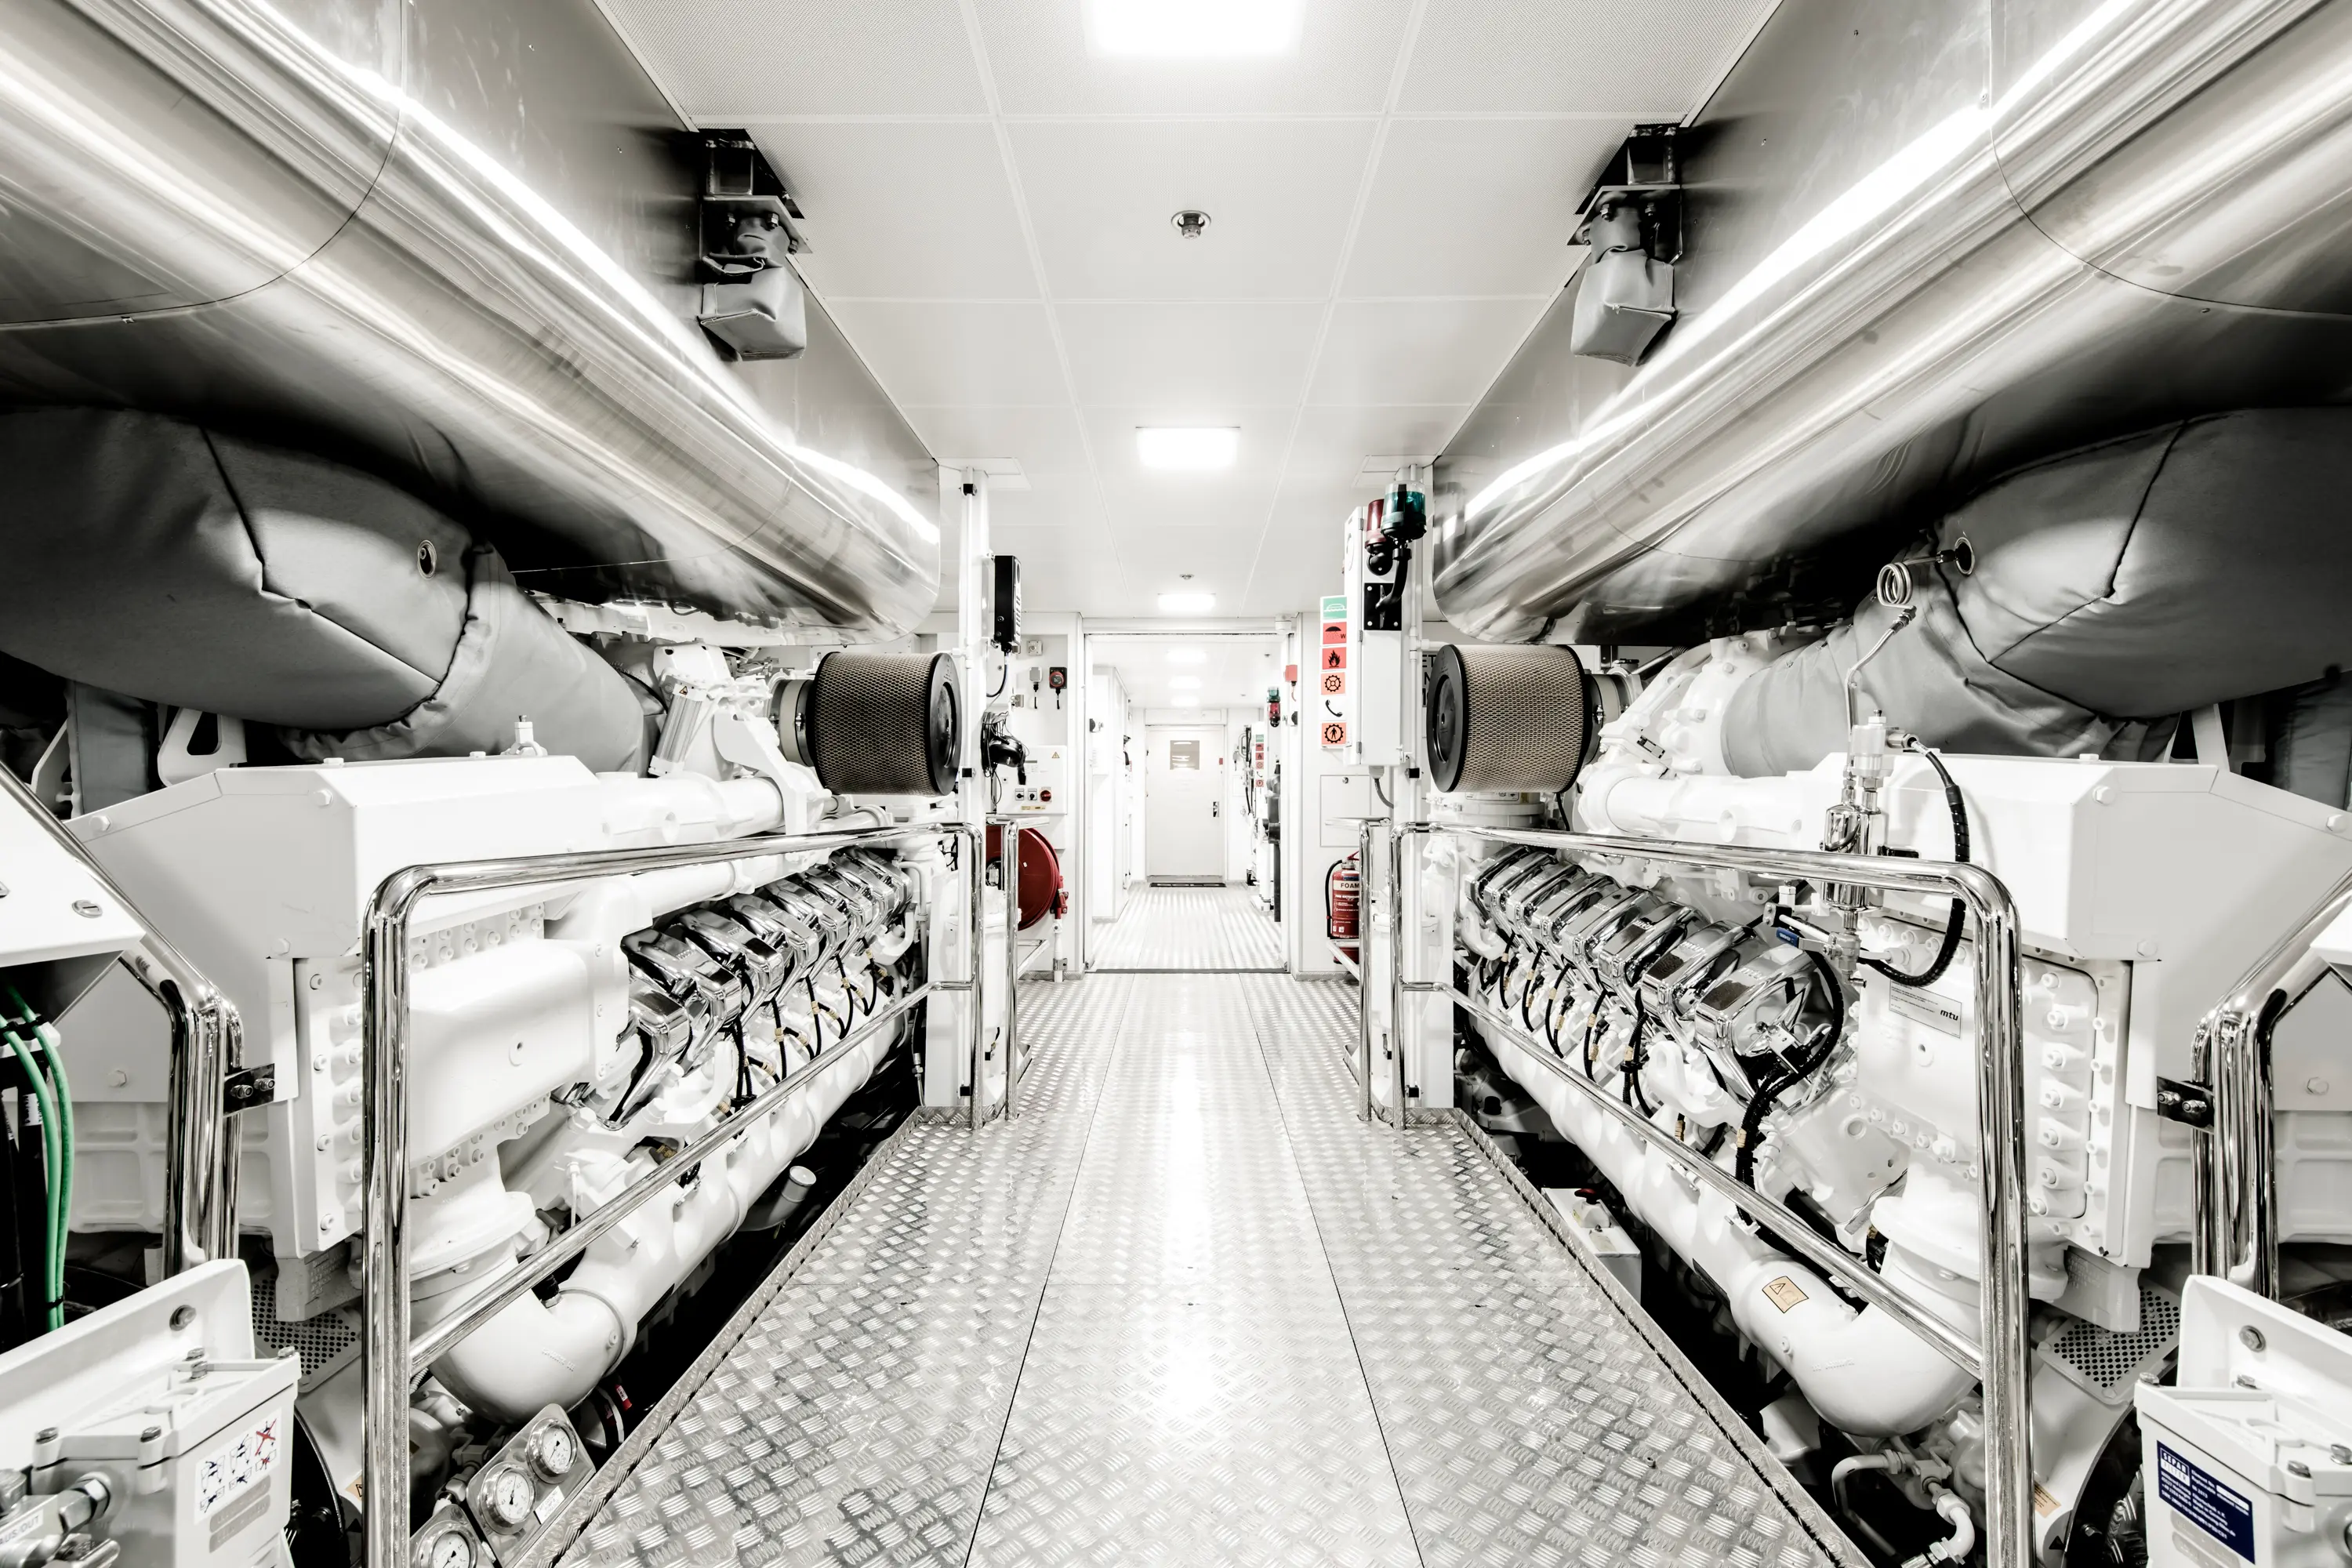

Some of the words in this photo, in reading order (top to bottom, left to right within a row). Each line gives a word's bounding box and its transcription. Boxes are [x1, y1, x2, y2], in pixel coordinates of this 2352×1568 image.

[1940, 1009, 1958, 1021] mtu
[2163, 1451, 2186, 1473] SEPAR
[2164, 1461, 2186, 1482] FILTER
